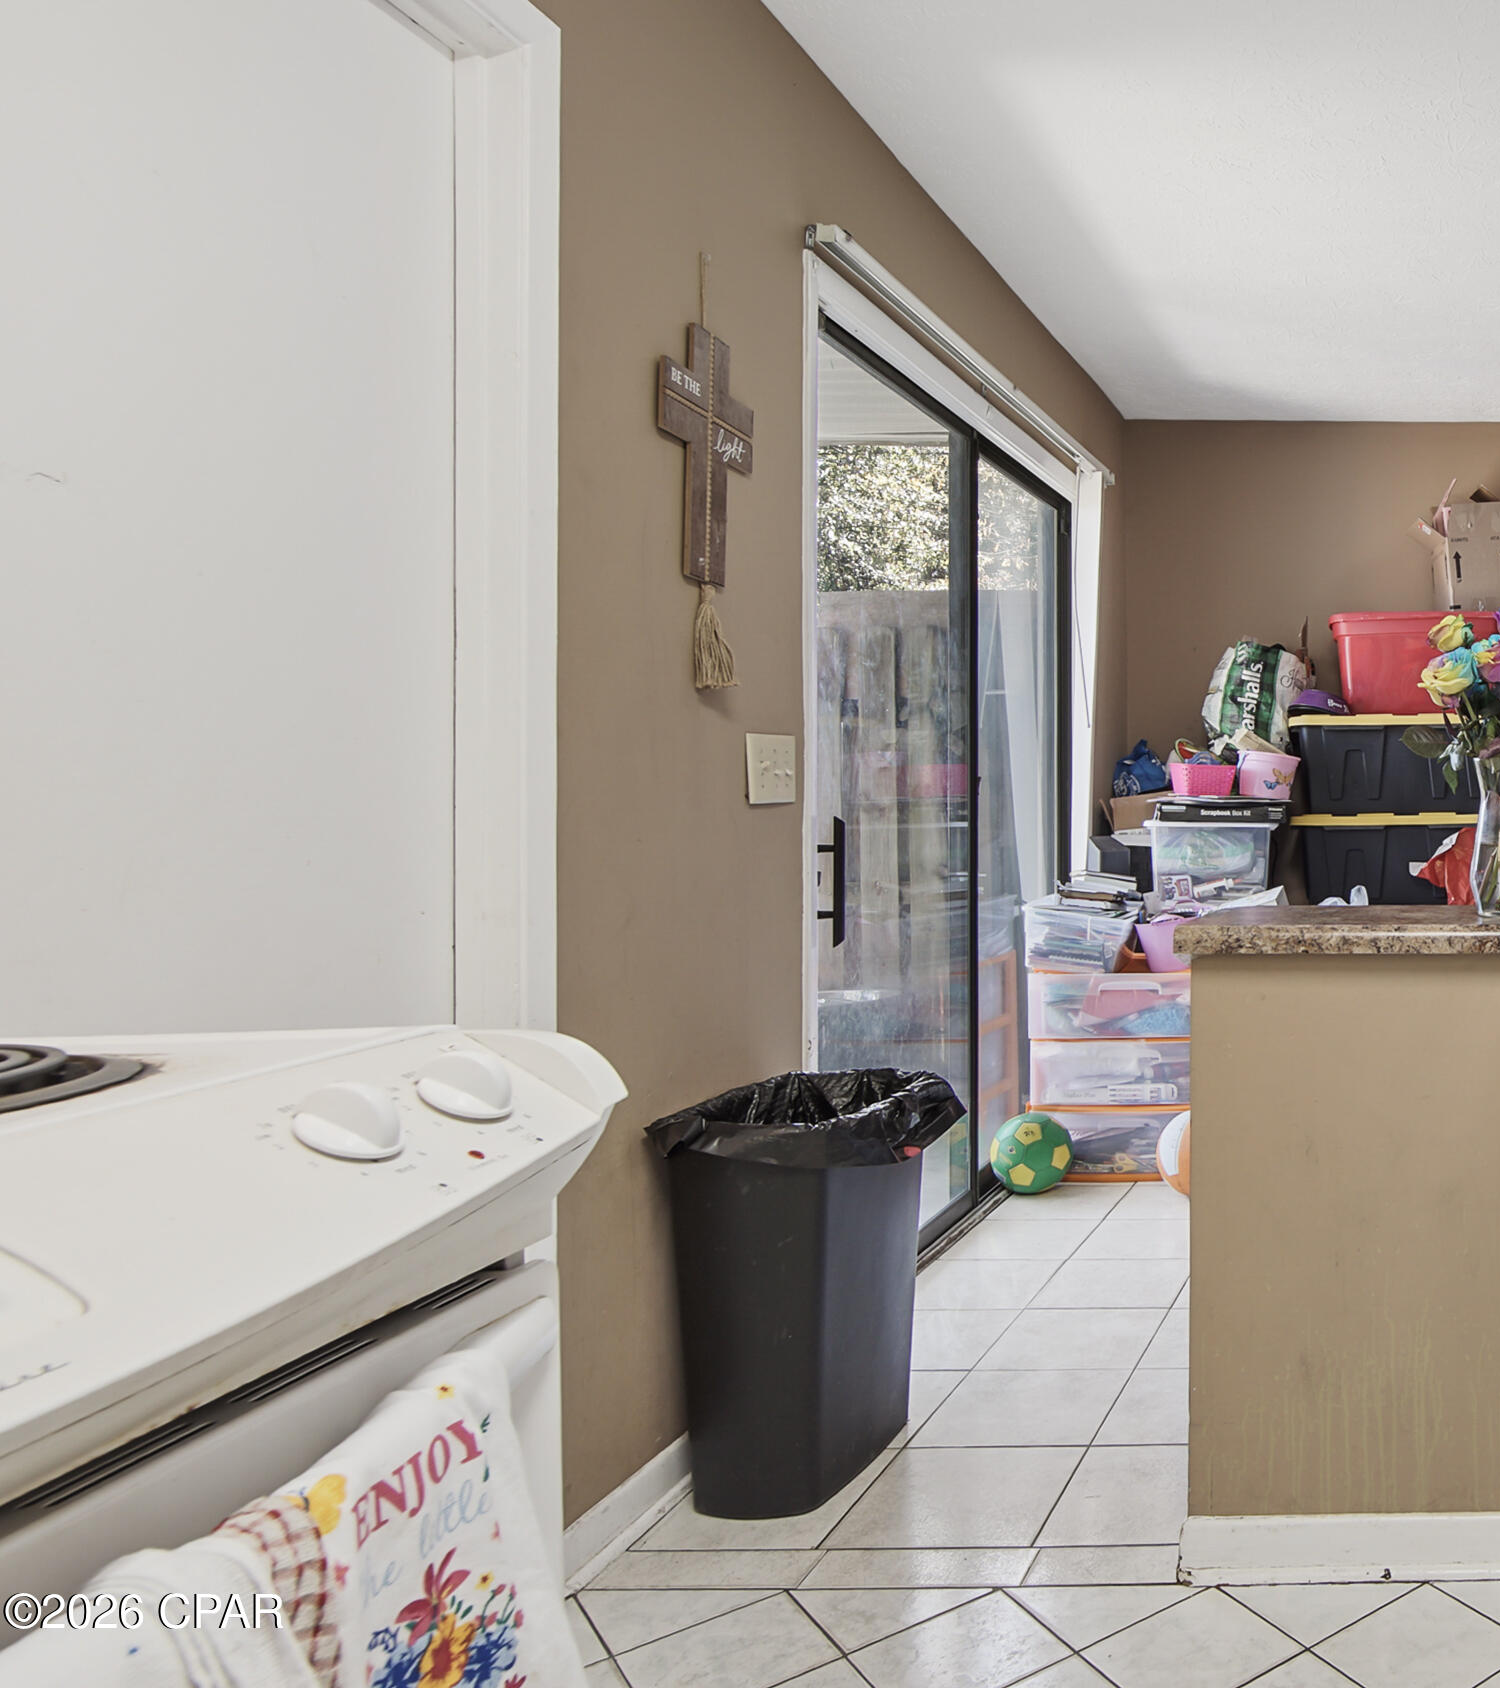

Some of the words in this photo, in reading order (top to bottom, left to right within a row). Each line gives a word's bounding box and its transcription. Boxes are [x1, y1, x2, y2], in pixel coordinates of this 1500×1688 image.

[671, 366, 682, 386] BE
[683, 374, 702, 397] THE
[713, 428, 746, 463] light
[1200, 809, 1231, 817] Scrapbook
[351, 1419, 483, 1552] ENJOY
